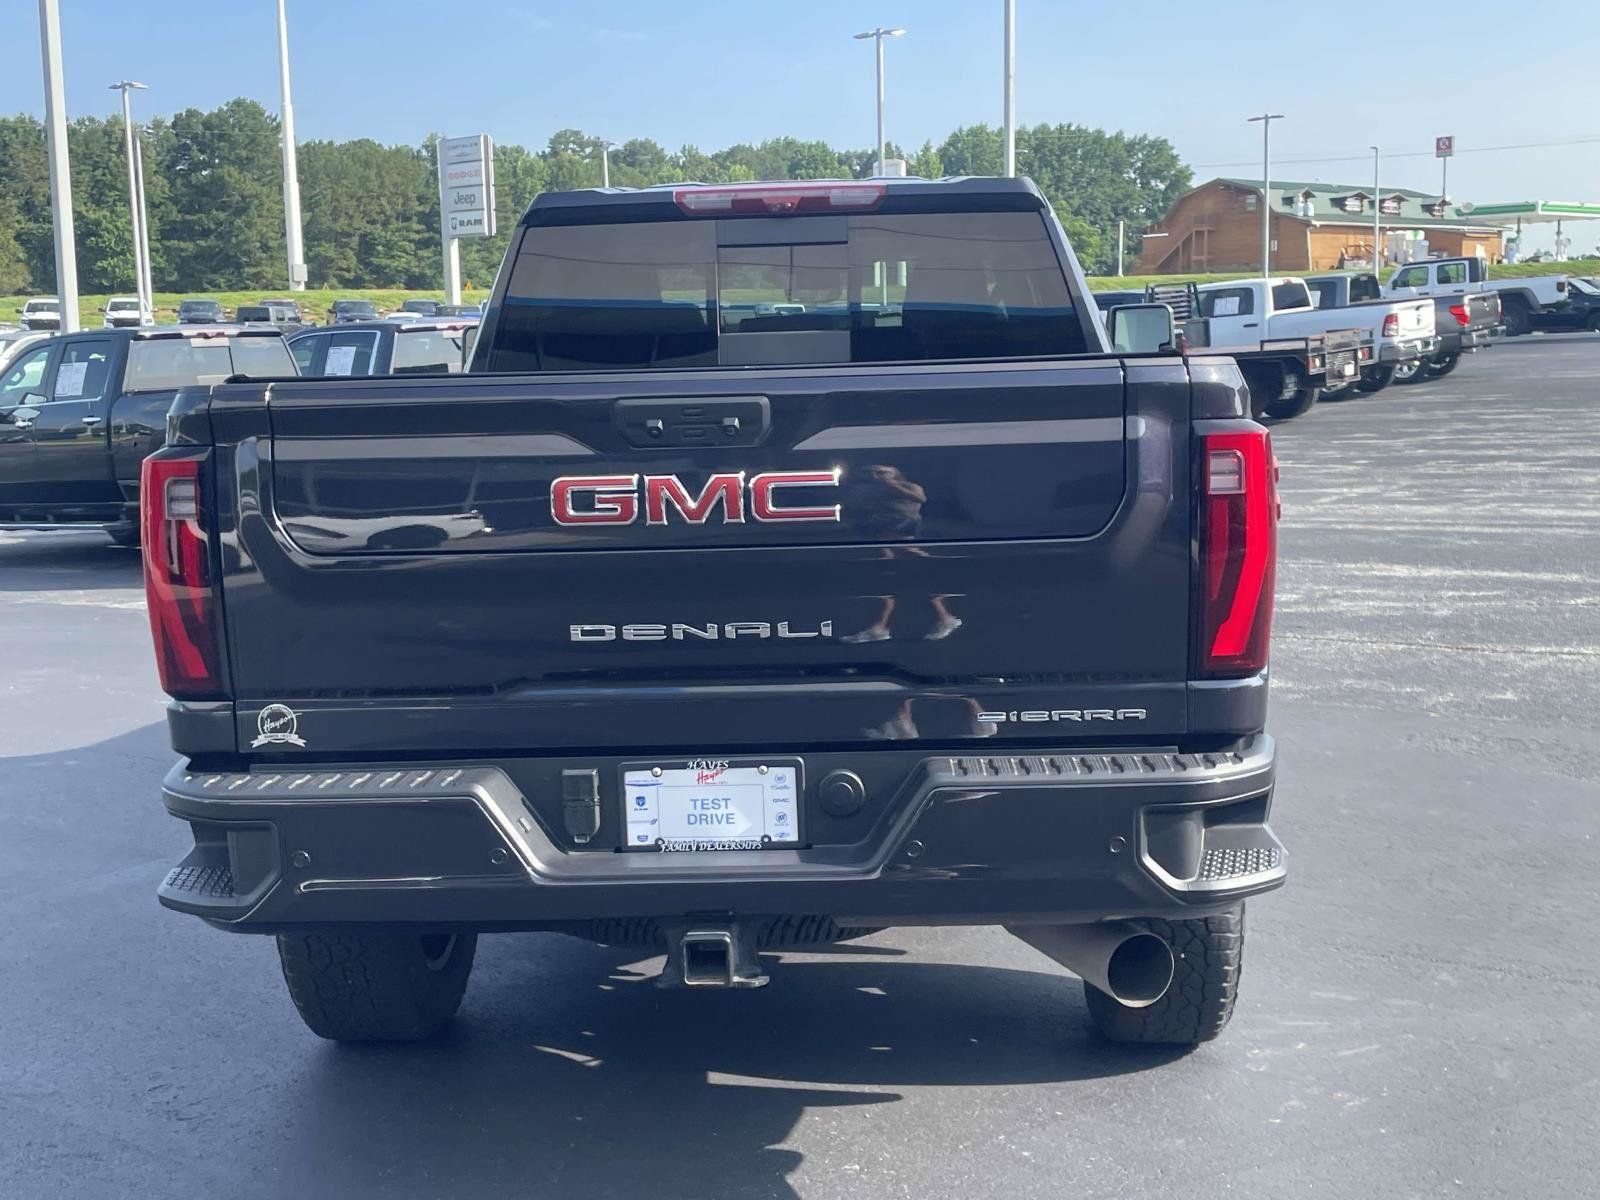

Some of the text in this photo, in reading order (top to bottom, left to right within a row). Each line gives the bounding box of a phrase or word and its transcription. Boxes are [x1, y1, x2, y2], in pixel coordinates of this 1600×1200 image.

[454, 191, 476, 206] Jeep
[458, 218, 483, 228] RAM
[550, 467, 842, 526] GMC
[569, 620, 833, 642] DENALI
[977, 708, 1147, 722] SIERRA
[690, 798, 732, 811] TEST
[687, 813, 736, 826] DRIVE
